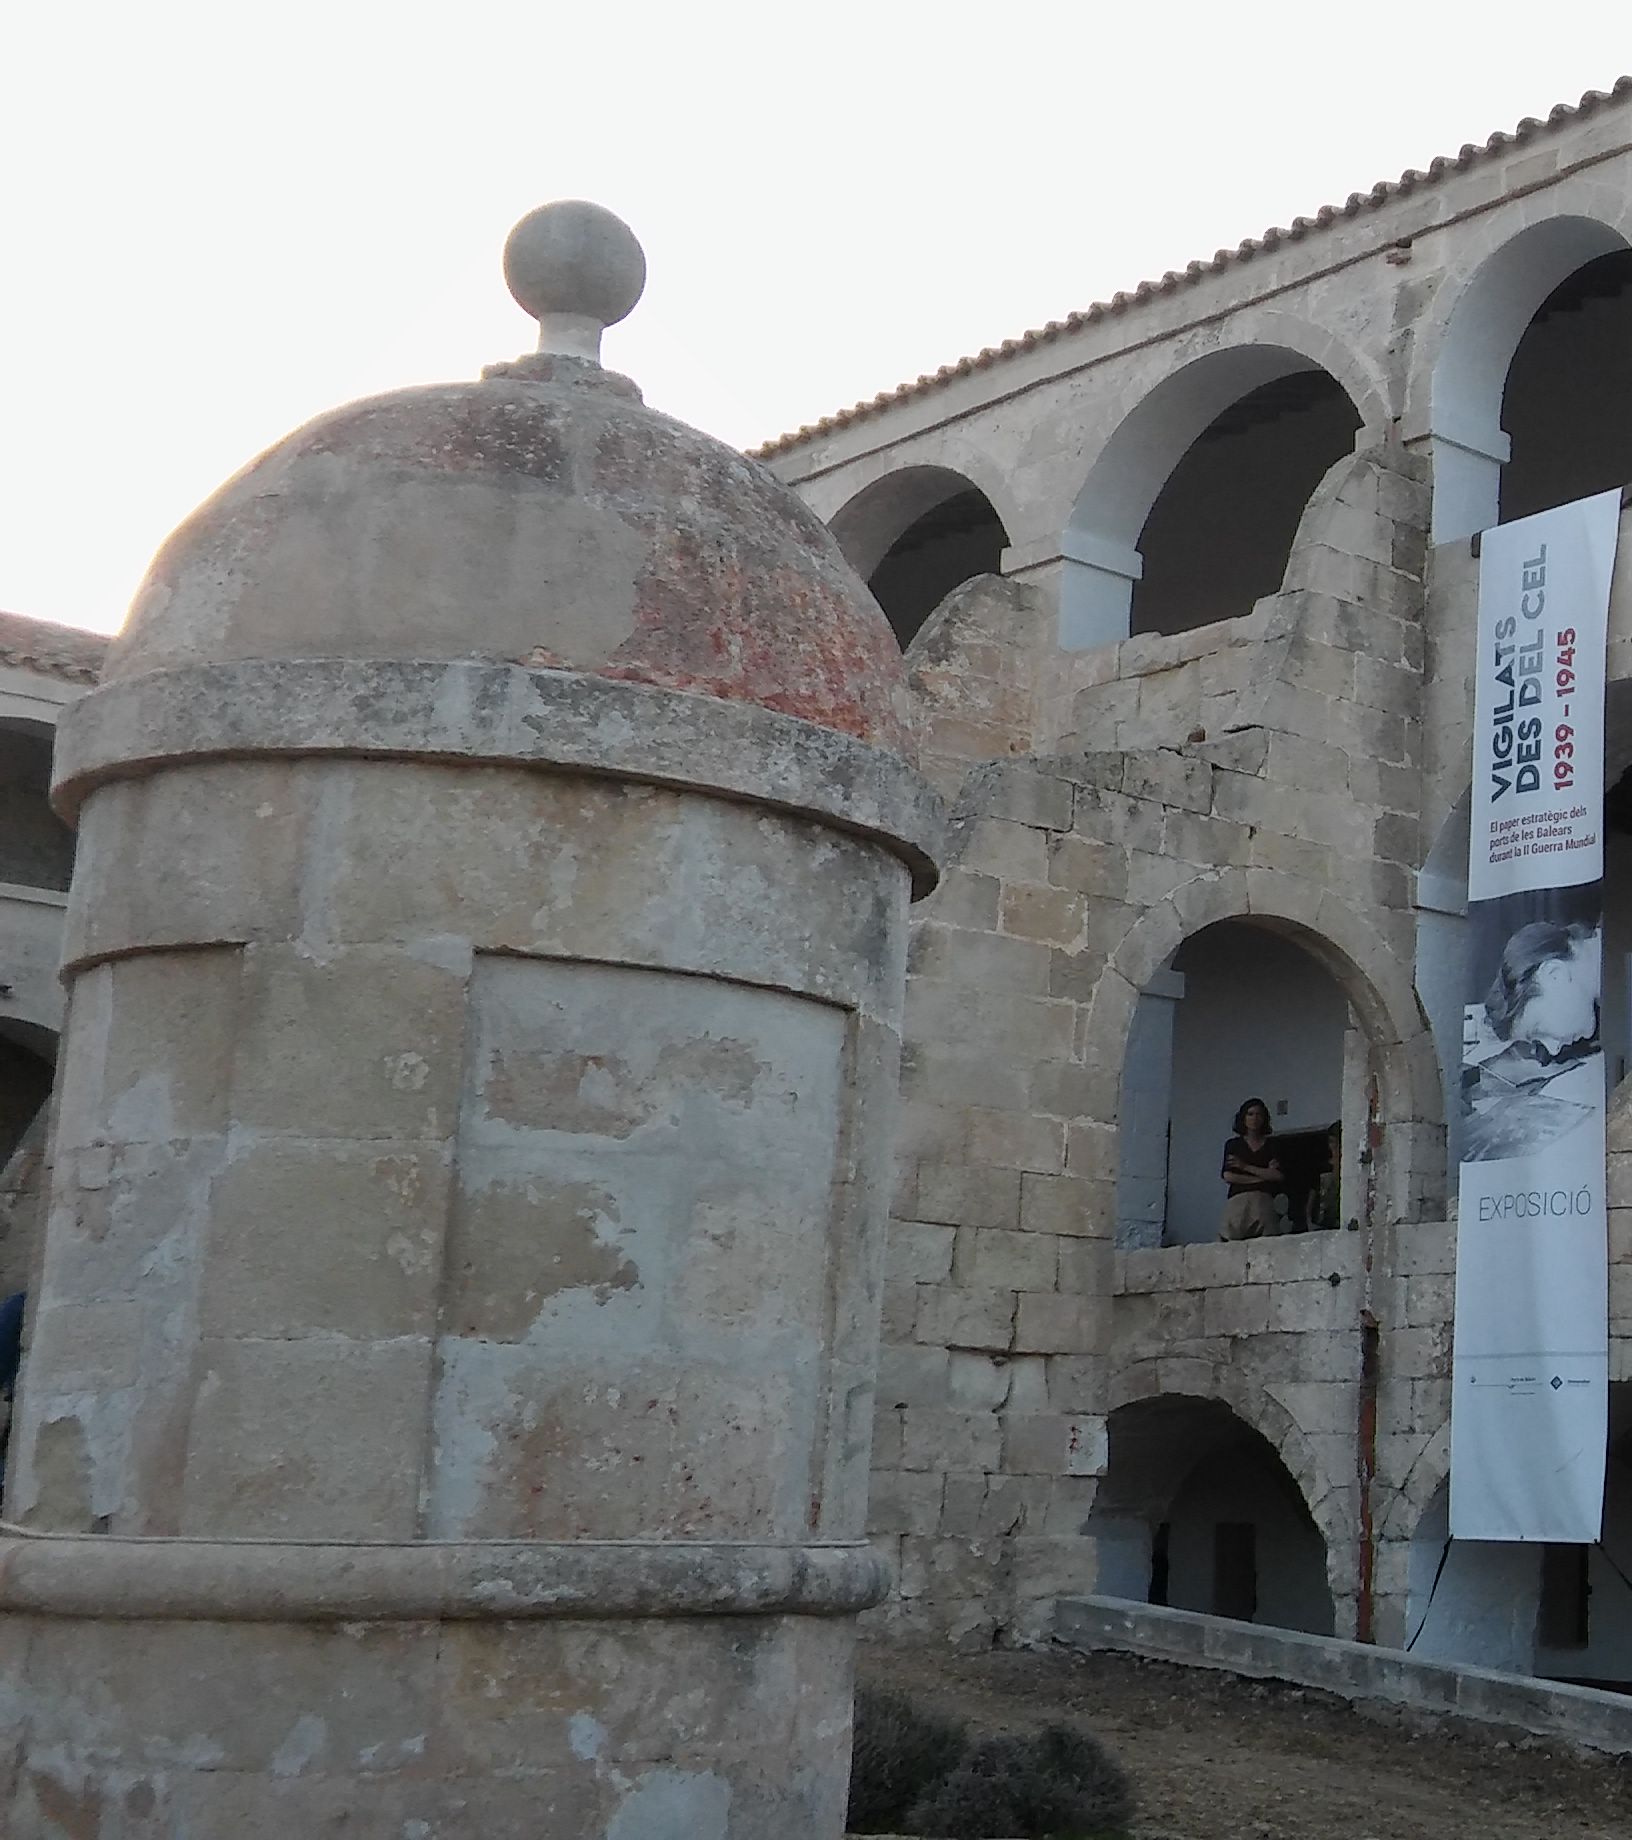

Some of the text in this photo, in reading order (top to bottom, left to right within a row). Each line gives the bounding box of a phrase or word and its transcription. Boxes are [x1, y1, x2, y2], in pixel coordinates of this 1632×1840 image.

[1516, 543, 1547, 794] DES DEL CEL
[1556, 627, 1577, 698] 1945
[1491, 615, 1517, 803] VIGILATS
[1553, 723, 1575, 791] 1939
[1489, 825, 1573, 851] ports de les Balears
[1490, 805, 1587, 833] El paper estratègic dels
[1489, 848, 1512, 863] durant
[1514, 845, 1522, 857] la
[1531, 842, 1563, 855] Guerra
[1565, 832, 1597, 851] Mundial
[1479, 1184, 1591, 1222] EXPOSICIÓ
